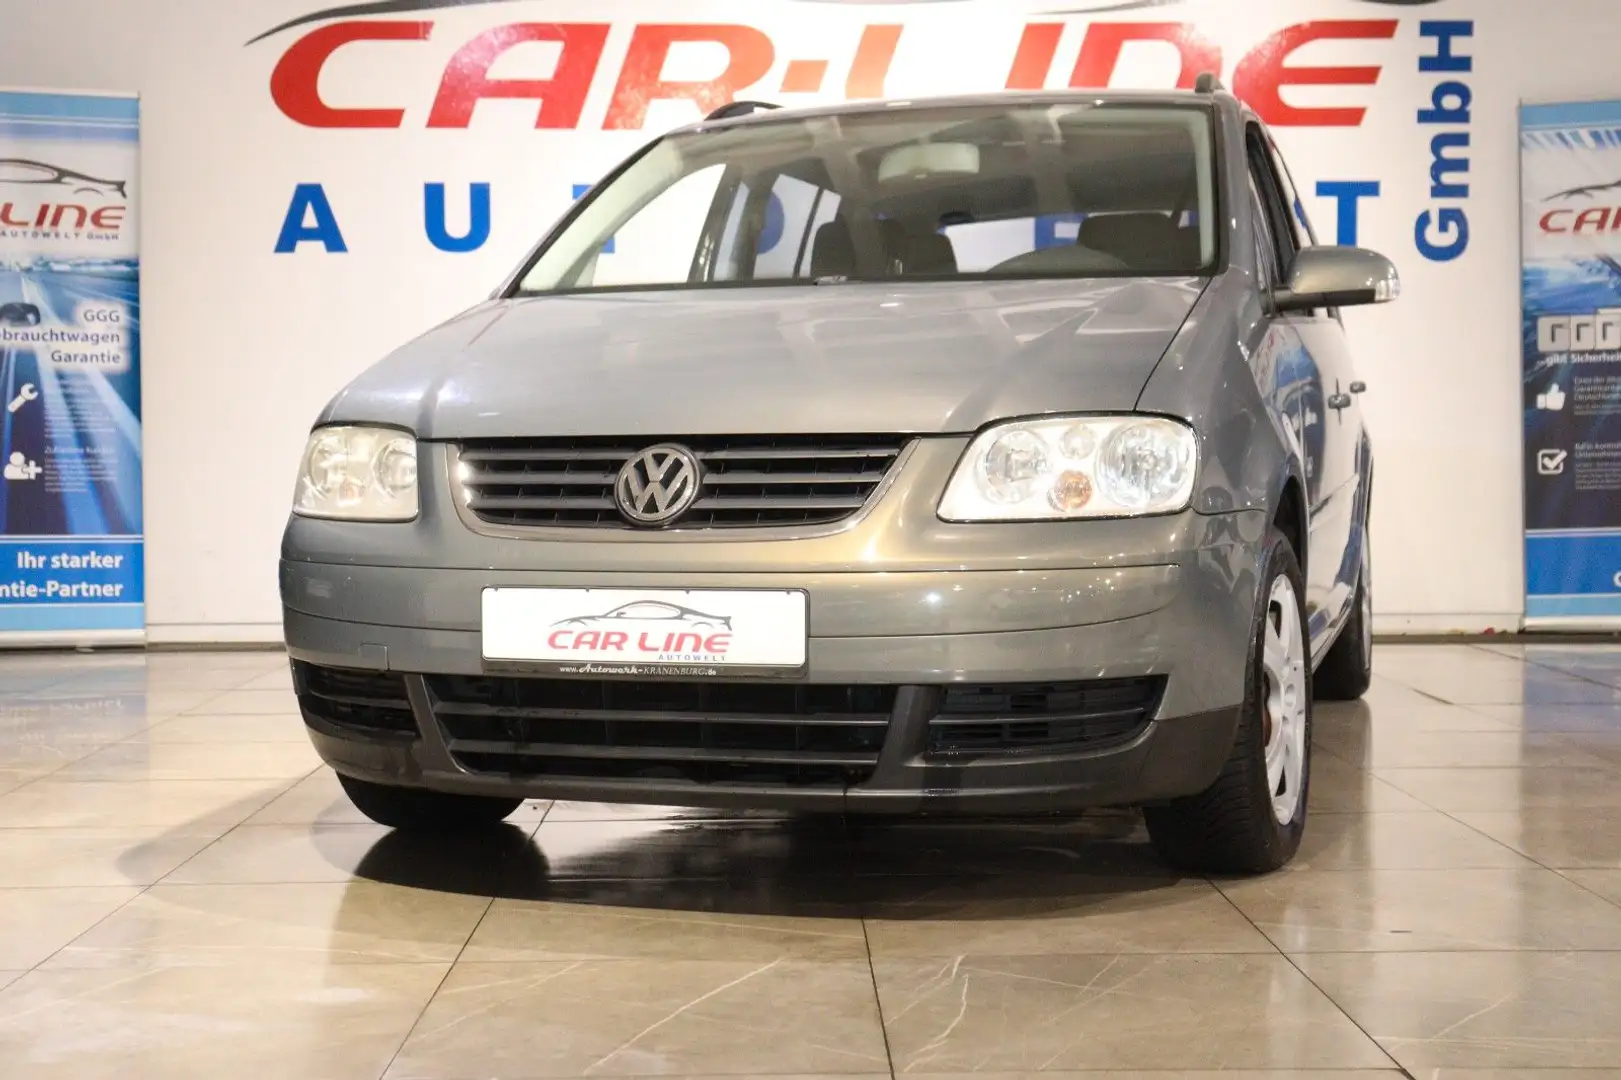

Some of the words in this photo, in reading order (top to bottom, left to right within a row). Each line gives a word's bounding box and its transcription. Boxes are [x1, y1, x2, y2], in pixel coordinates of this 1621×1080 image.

[1414, 20, 1474, 262] GmbH
[0, 202, 127, 230] LINE
[0, 230, 80, 239] AUTOWELT
[83, 309, 120, 323] GGG
[0, 328, 120, 345] brauchtwagen
[51, 350, 120, 364] Garantie
[17, 551, 46, 569] Ihr
[51, 551, 124, 569] starker
[547, 630, 629, 651] CAR
[638, 632, 732, 653] LINE
[658, 654, 725, 662] AUTOWELT
